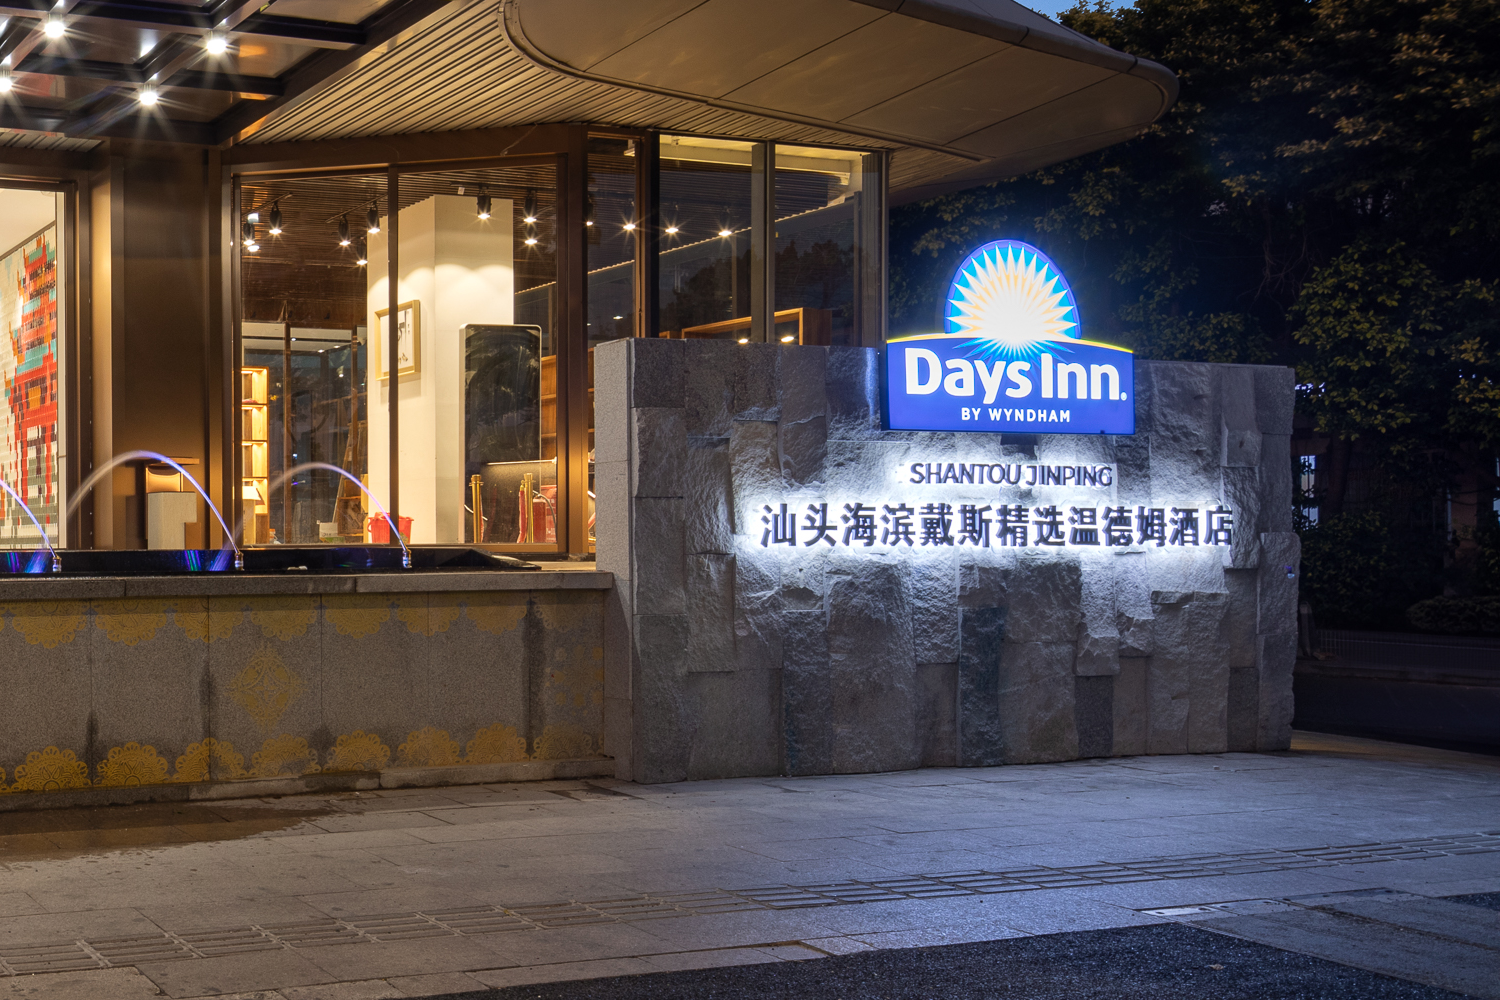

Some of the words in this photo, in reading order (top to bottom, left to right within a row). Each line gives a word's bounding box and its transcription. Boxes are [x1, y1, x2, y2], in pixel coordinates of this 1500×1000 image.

[905, 348, 1032, 404] Days
[1041, 353, 1120, 400] Inn
[961, 407, 981, 421] BY
[988, 408, 1070, 423] WYNDHAM
[909, 463, 1021, 485] SHANTOU
[1025, 465, 1113, 486] JINPING
[760, 502, 1234, 548] 汕头海滨戴斯精选温德姆酒店
